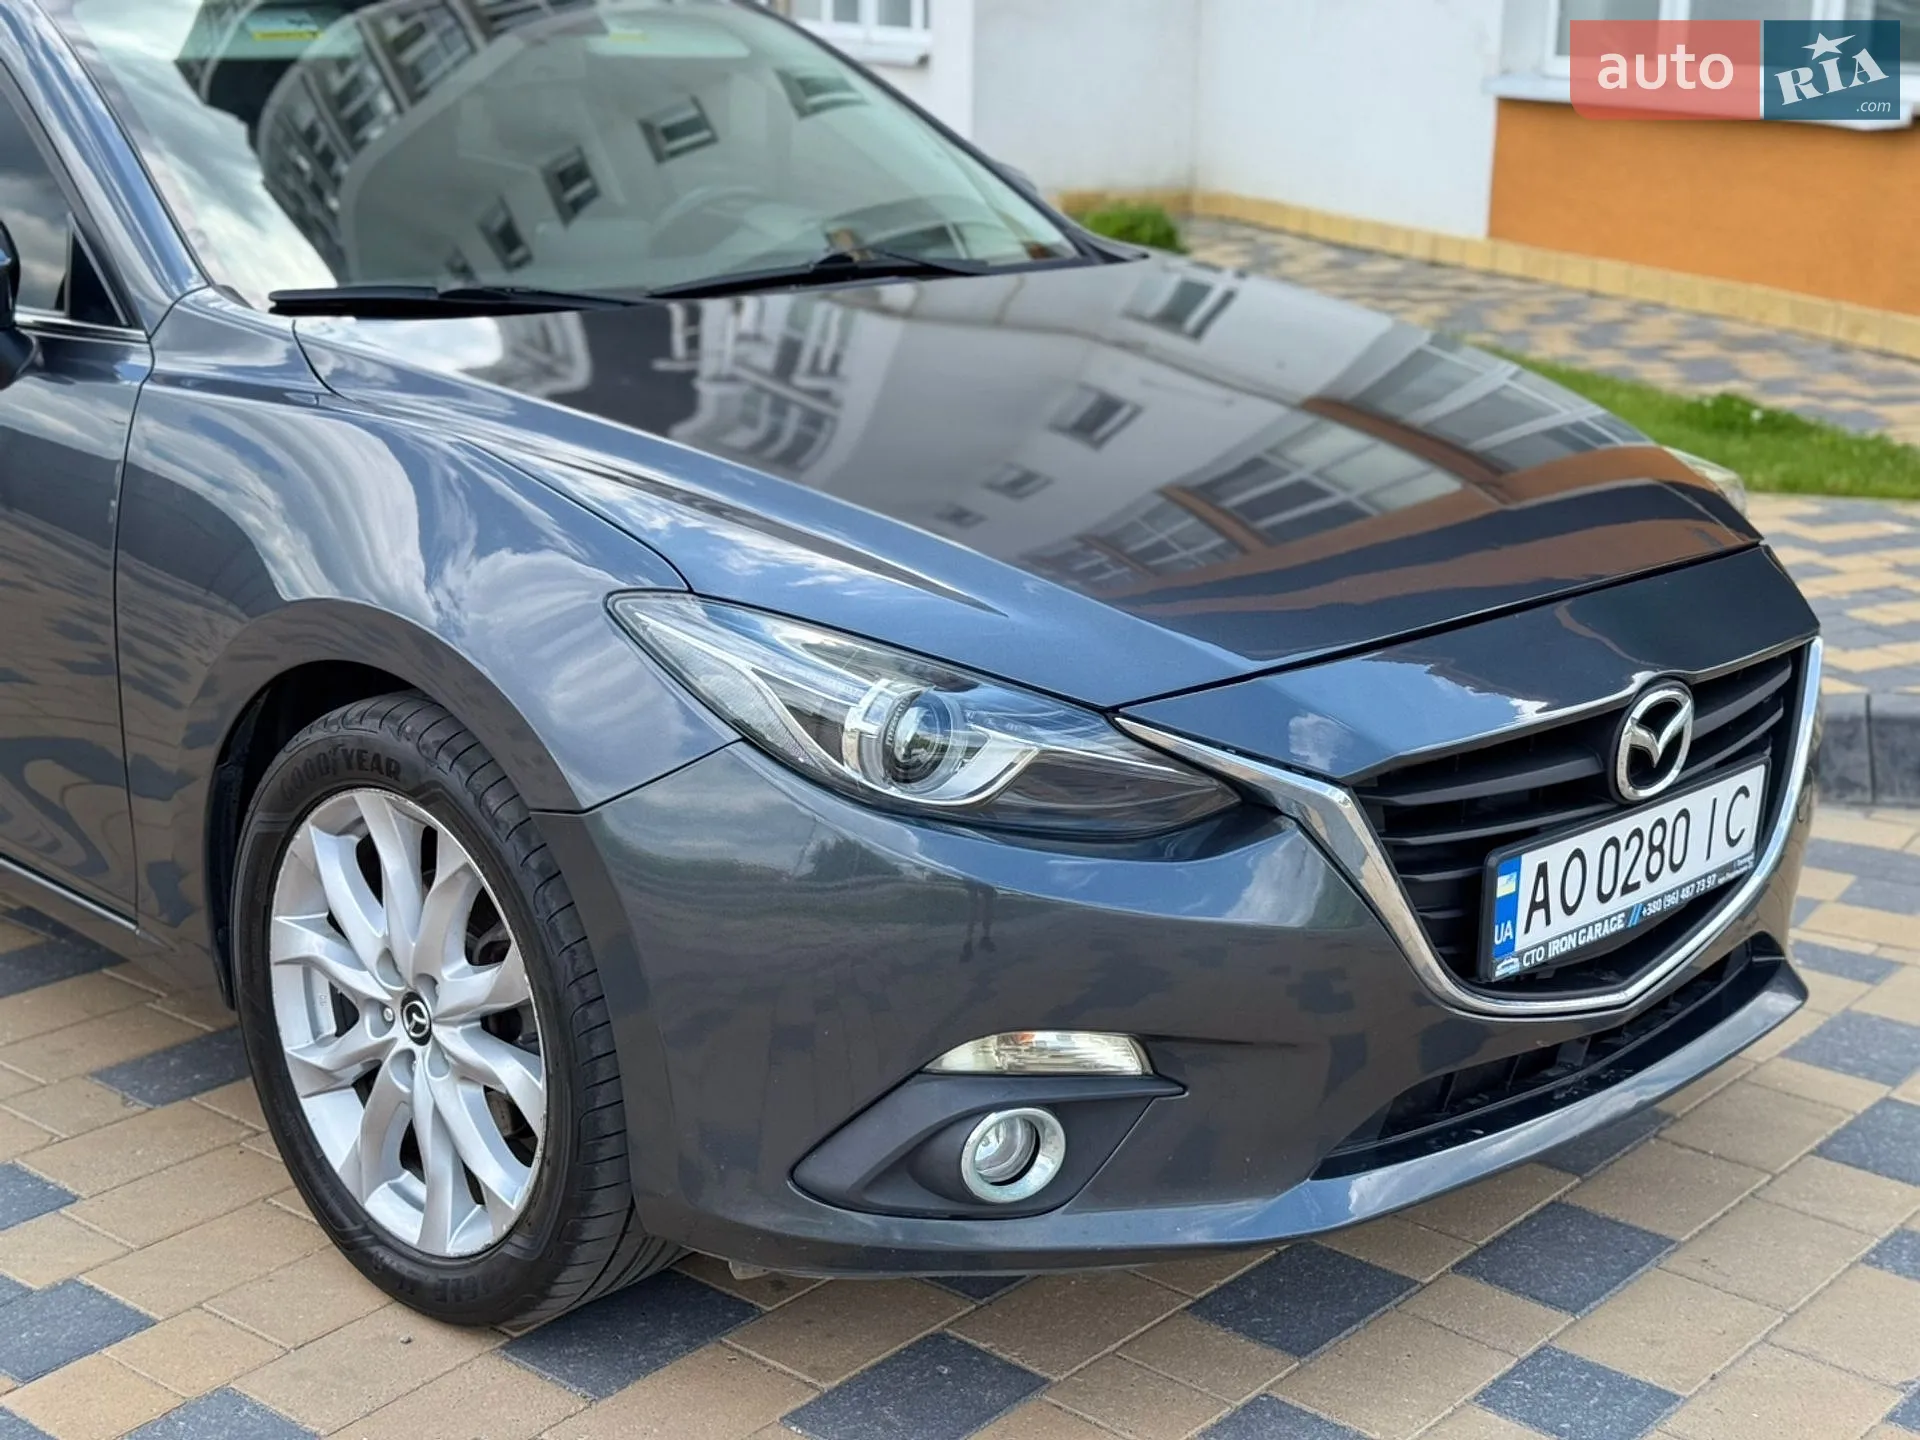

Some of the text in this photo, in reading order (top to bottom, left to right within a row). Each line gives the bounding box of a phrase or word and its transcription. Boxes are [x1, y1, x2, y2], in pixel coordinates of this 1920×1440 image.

[1524, 784, 1750, 935] AO 0280 IC
[1494, 919, 1514, 945] UA
[1548, 931, 1578, 958] IRON
[1578, 911, 1626, 946] GARAGE
[1706, 873, 1717, 888] 97
